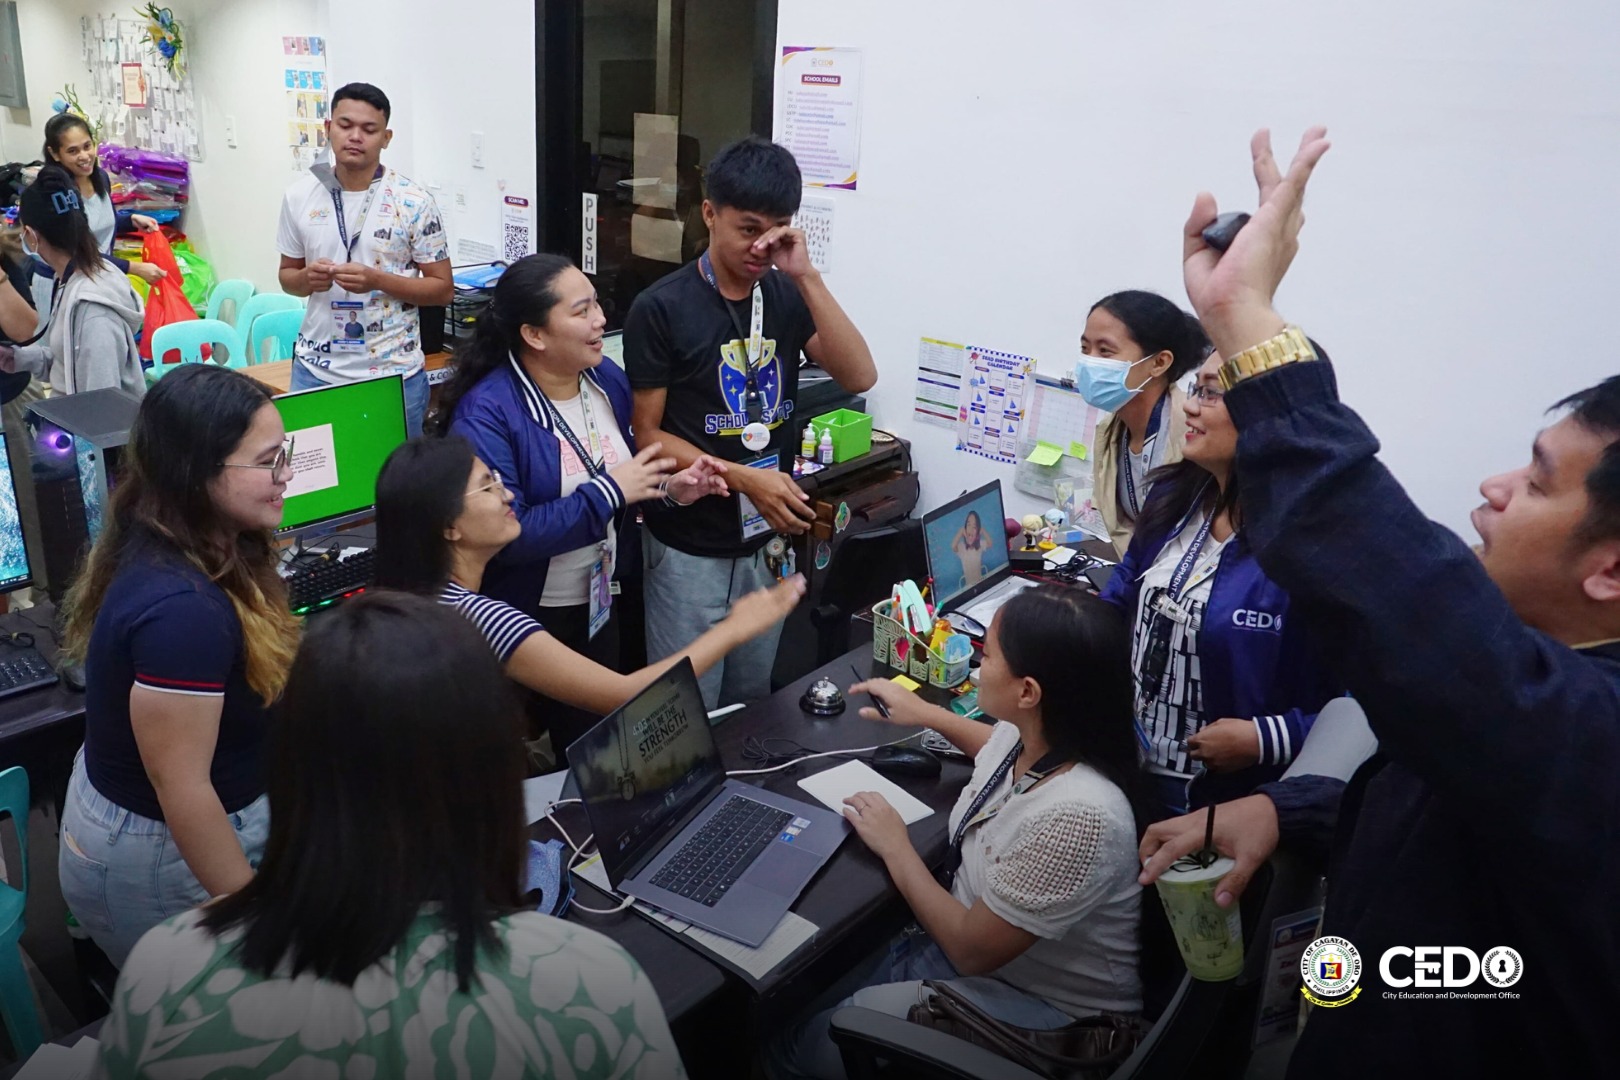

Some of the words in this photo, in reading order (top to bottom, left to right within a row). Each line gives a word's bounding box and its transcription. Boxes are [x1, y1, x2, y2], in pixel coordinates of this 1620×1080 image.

[585, 198, 594, 271] PUSH
[298, 332, 331, 354] Proud
[987, 362, 1013, 370] CALENDAR
[995, 358, 1020, 367] BIRTHDAY
[558, 422, 587, 462] DEVELOPMENT
[1172, 544, 1200, 592] DEVELOPMENT
[657, 715, 664, 724] BE
[664, 704, 676, 718] THE
[639, 708, 687, 757] STRENGTH
[996, 742, 1023, 778] DUCATION
